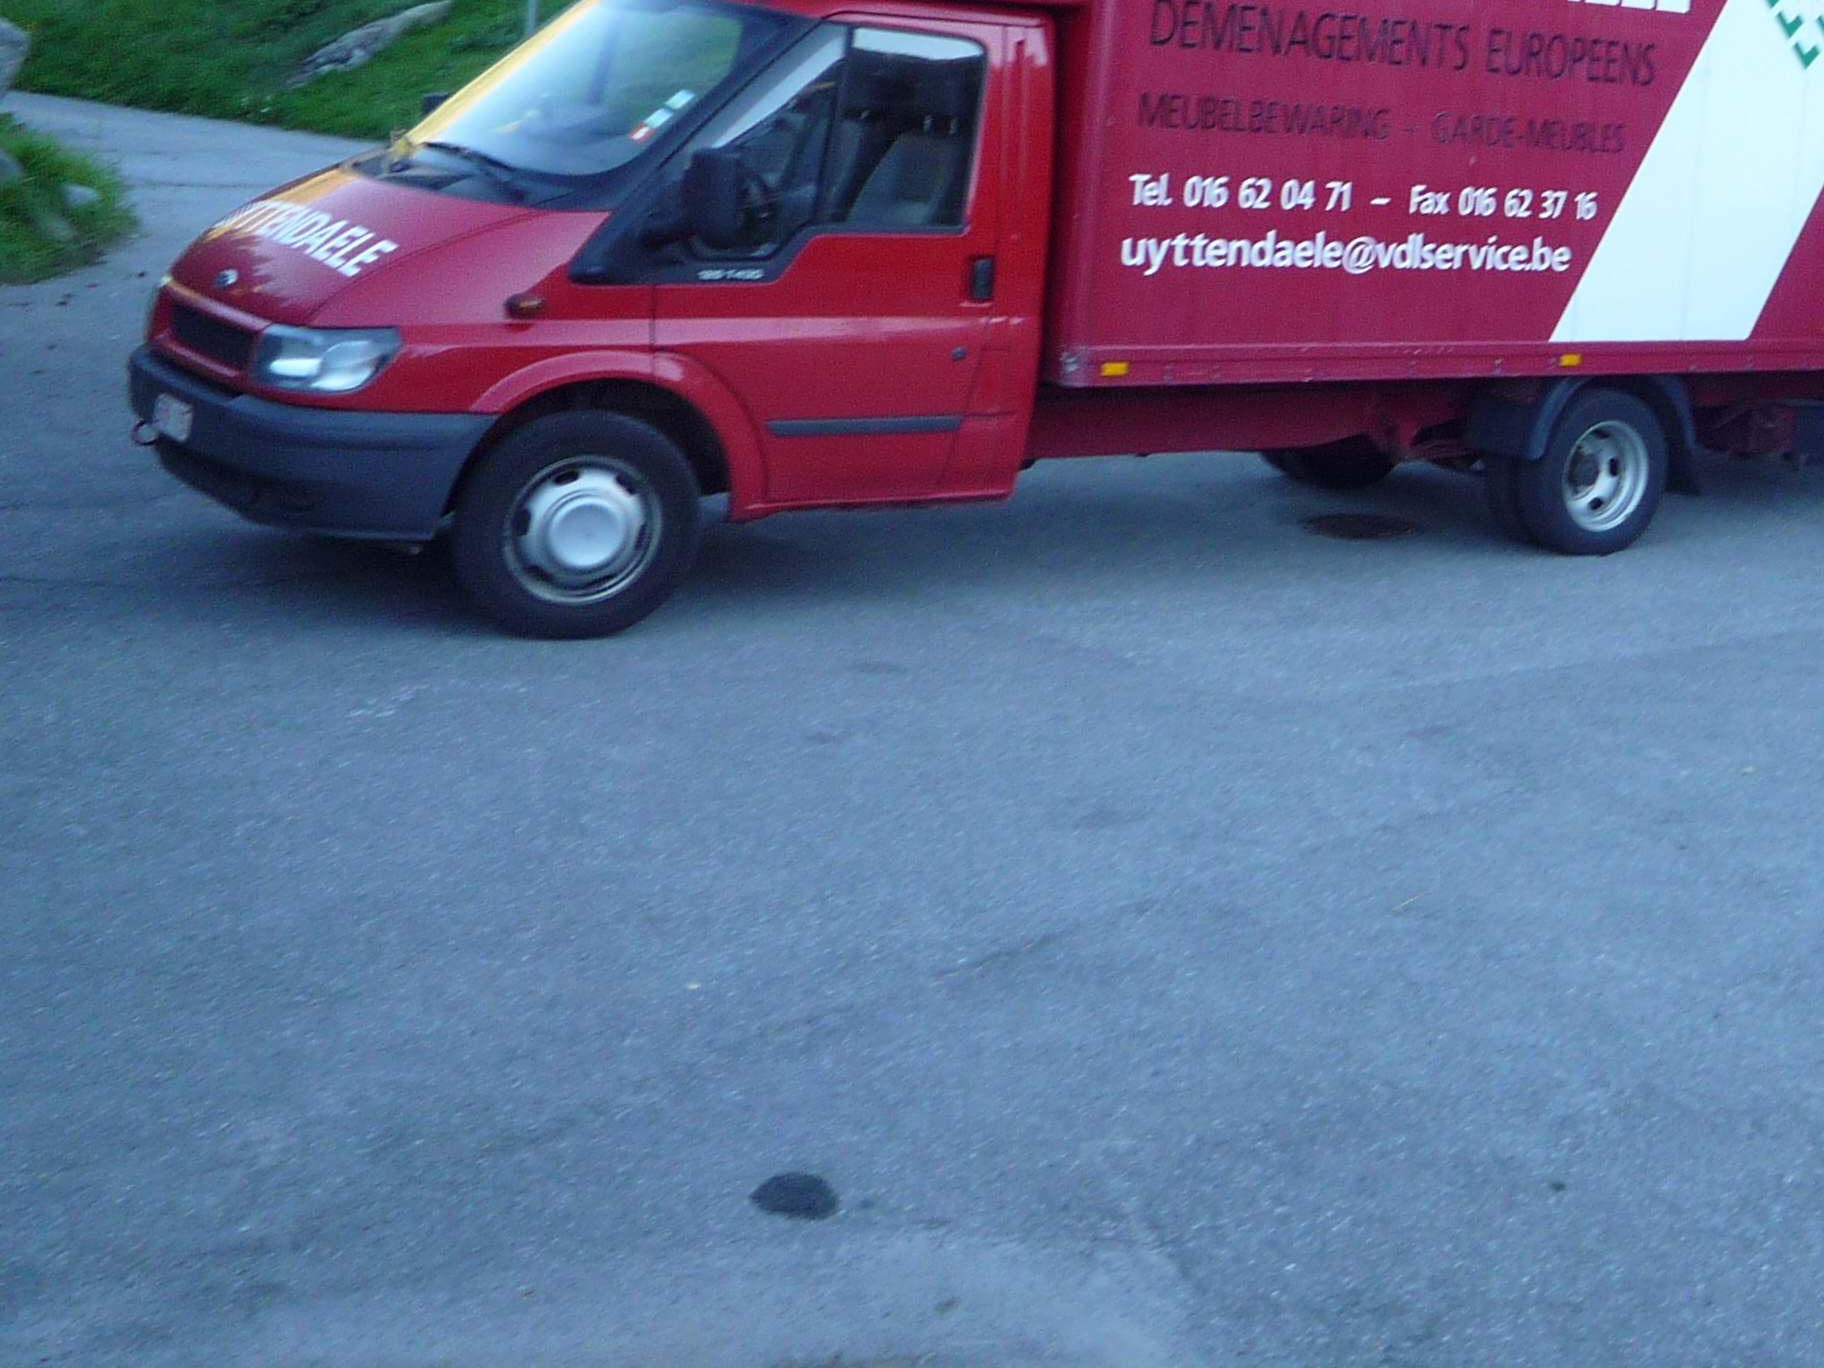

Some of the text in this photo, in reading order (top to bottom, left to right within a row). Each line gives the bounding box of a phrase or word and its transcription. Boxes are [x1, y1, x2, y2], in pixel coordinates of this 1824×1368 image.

[1485, 28, 1656, 87] EUROPEENS
[1128, 173, 1172, 206] Tel.
[1182, 175, 1229, 208] 016
[1237, 177, 1272, 209] 62
[1280, 179, 1315, 211] 04
[1325, 181, 1352, 211] 71
[1409, 184, 1451, 216] Fax
[1458, 185, 1497, 217] 016
[1504, 187, 1533, 218] 62
[1539, 189, 1567, 219] 37
[1575, 190, 1598, 220] 16
[1120, 230, 1572, 276] uyttendaele@vdlservice.be
